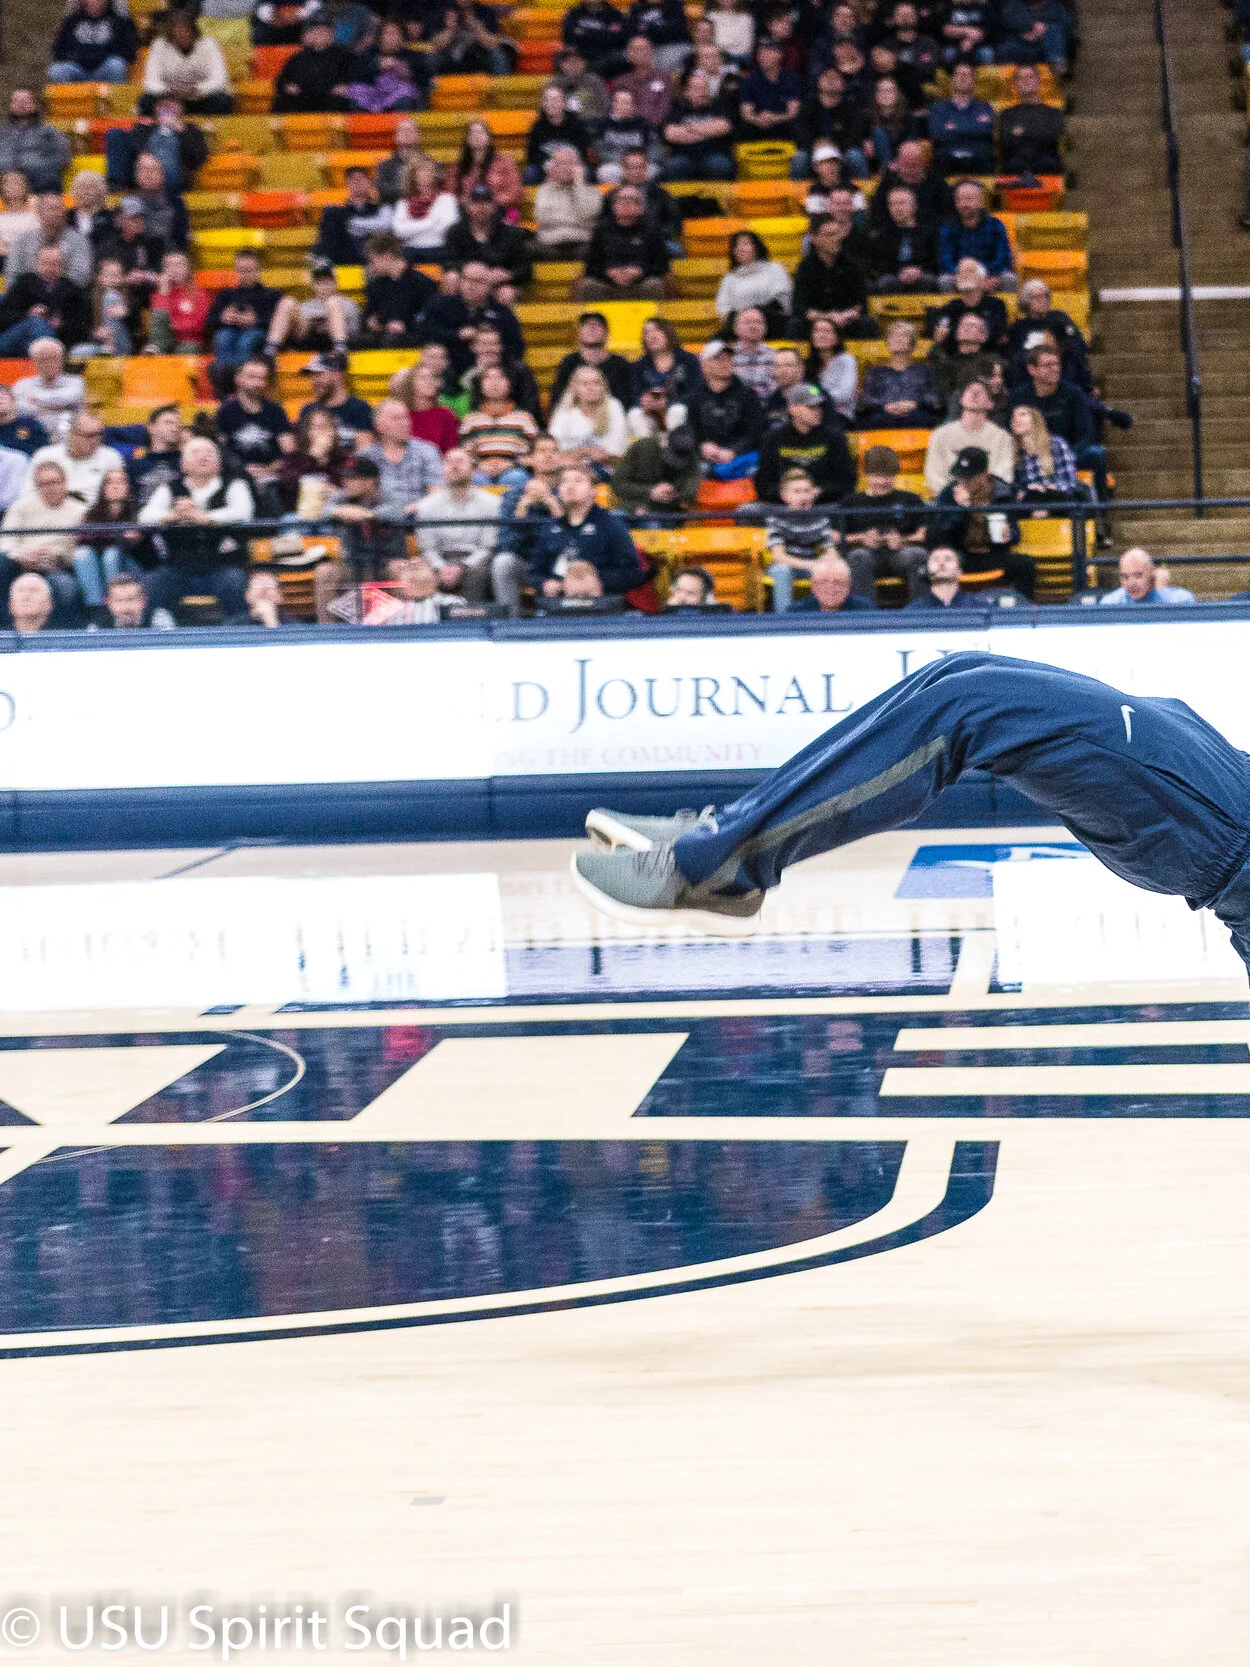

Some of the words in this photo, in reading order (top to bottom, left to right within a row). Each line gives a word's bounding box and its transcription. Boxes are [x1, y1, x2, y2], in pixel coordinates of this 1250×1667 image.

[569, 657, 855, 735] JOURNAL
[543, 748, 594, 767] THE
[600, 742, 765, 767] COMMUNITY
